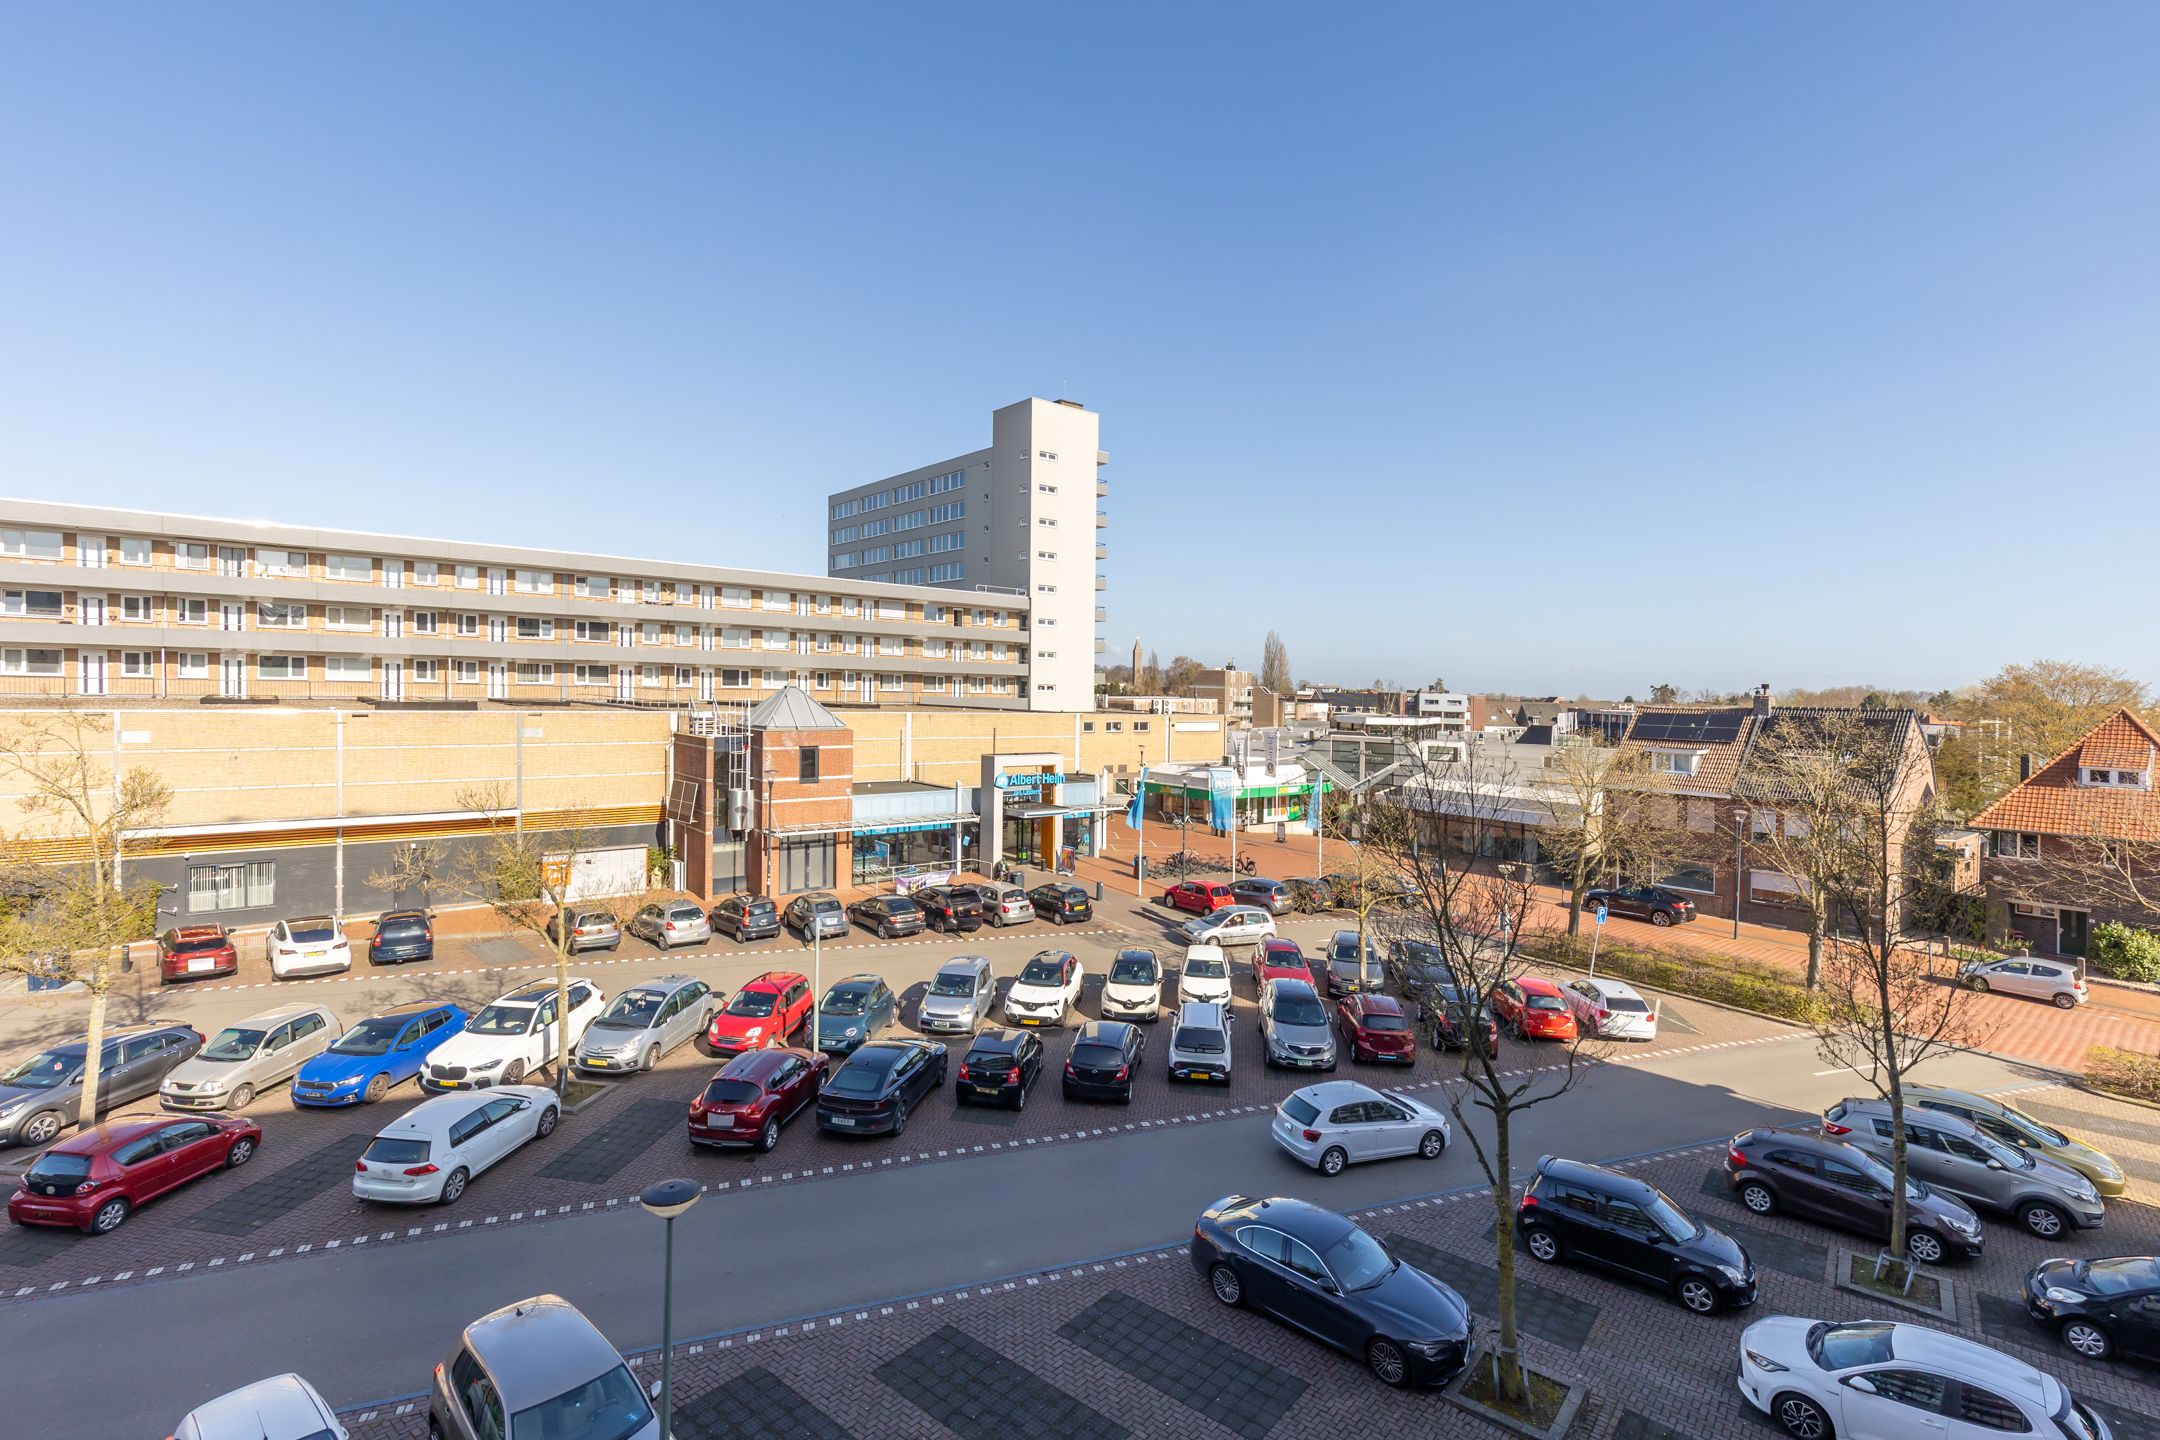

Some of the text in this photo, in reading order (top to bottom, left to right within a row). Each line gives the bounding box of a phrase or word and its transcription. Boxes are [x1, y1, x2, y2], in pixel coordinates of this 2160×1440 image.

[1010, 772, 1065, 785] Albert Heijn
[1600, 908, 1606, 917] P
